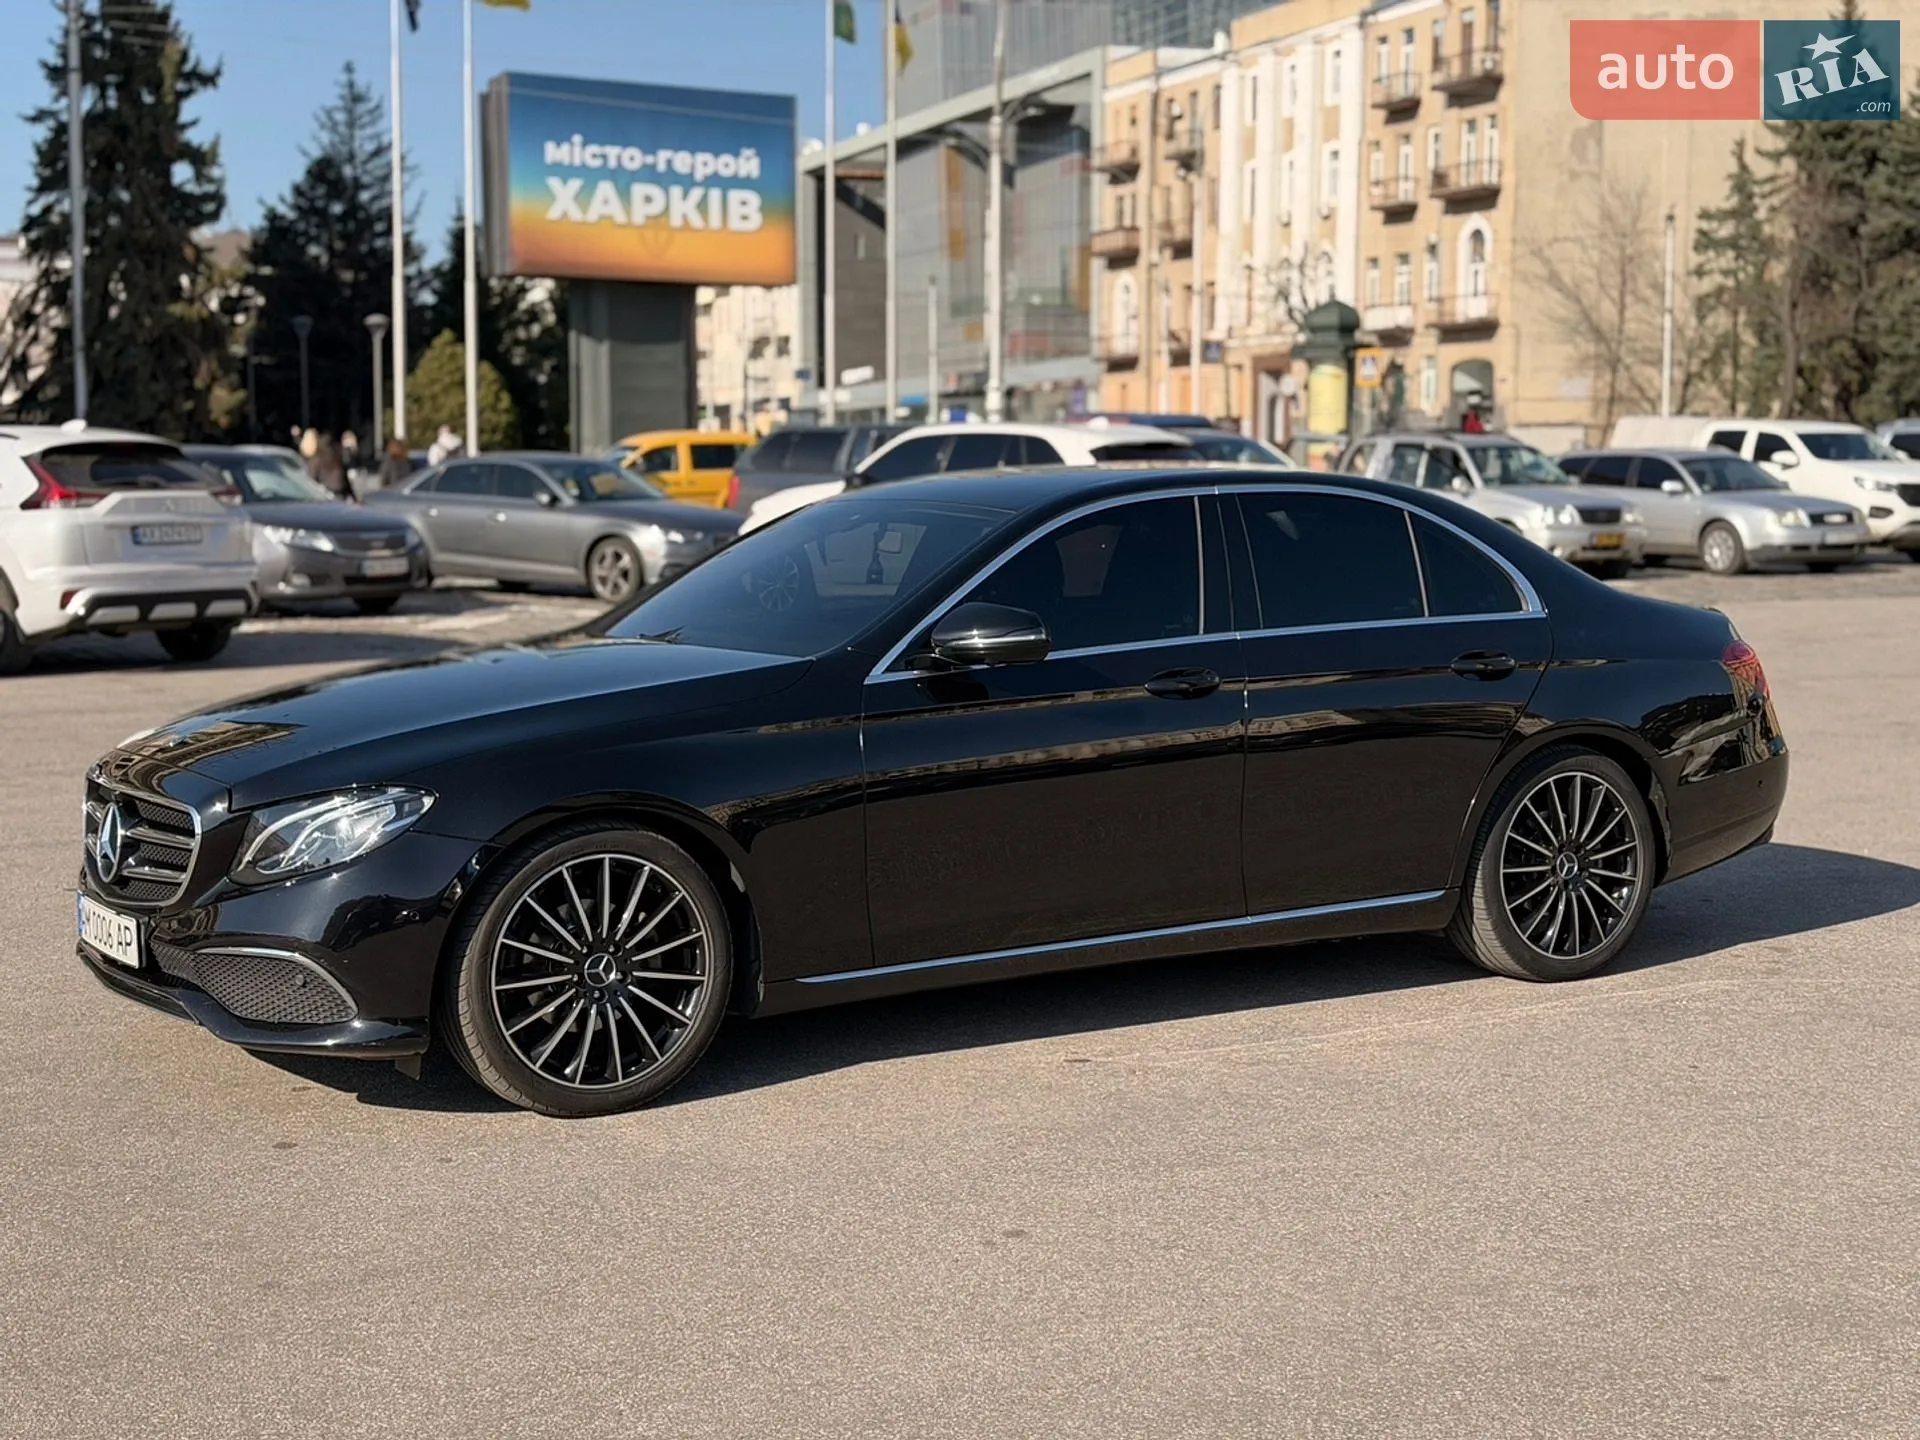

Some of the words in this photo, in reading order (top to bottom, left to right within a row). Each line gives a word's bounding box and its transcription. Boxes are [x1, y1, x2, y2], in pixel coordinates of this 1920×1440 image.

[543, 133, 761, 182] місто-герой
[545, 175, 764, 233] ХАРКІВ
[116, 922, 133, 956] AP
